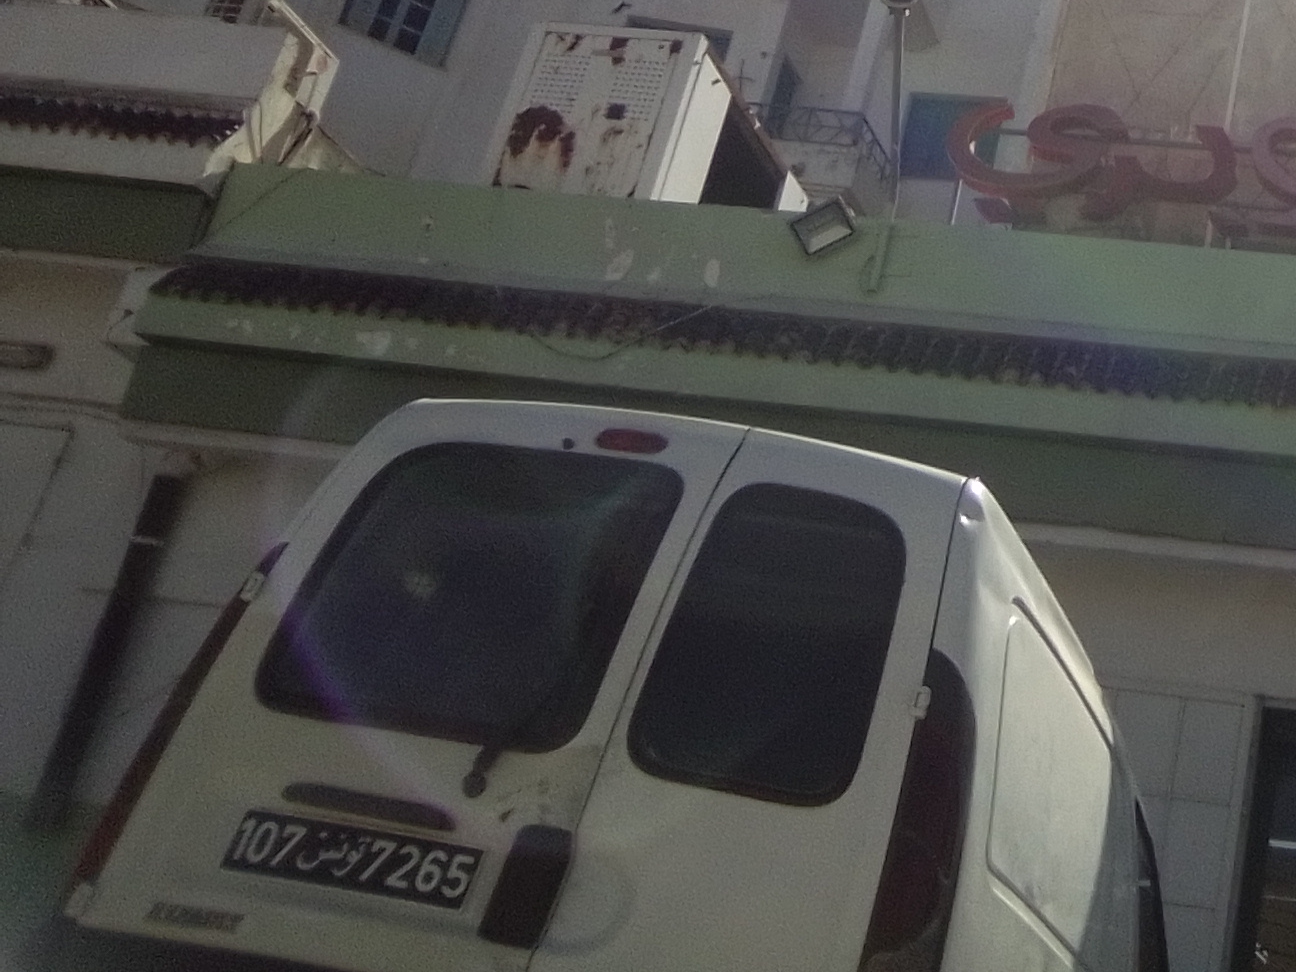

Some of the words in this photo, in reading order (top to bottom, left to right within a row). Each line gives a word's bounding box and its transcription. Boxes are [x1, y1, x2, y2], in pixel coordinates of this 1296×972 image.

[232, 817, 307, 867] 107
[296, 829, 370, 878] تونس
[359, 838, 475, 898] 7265
